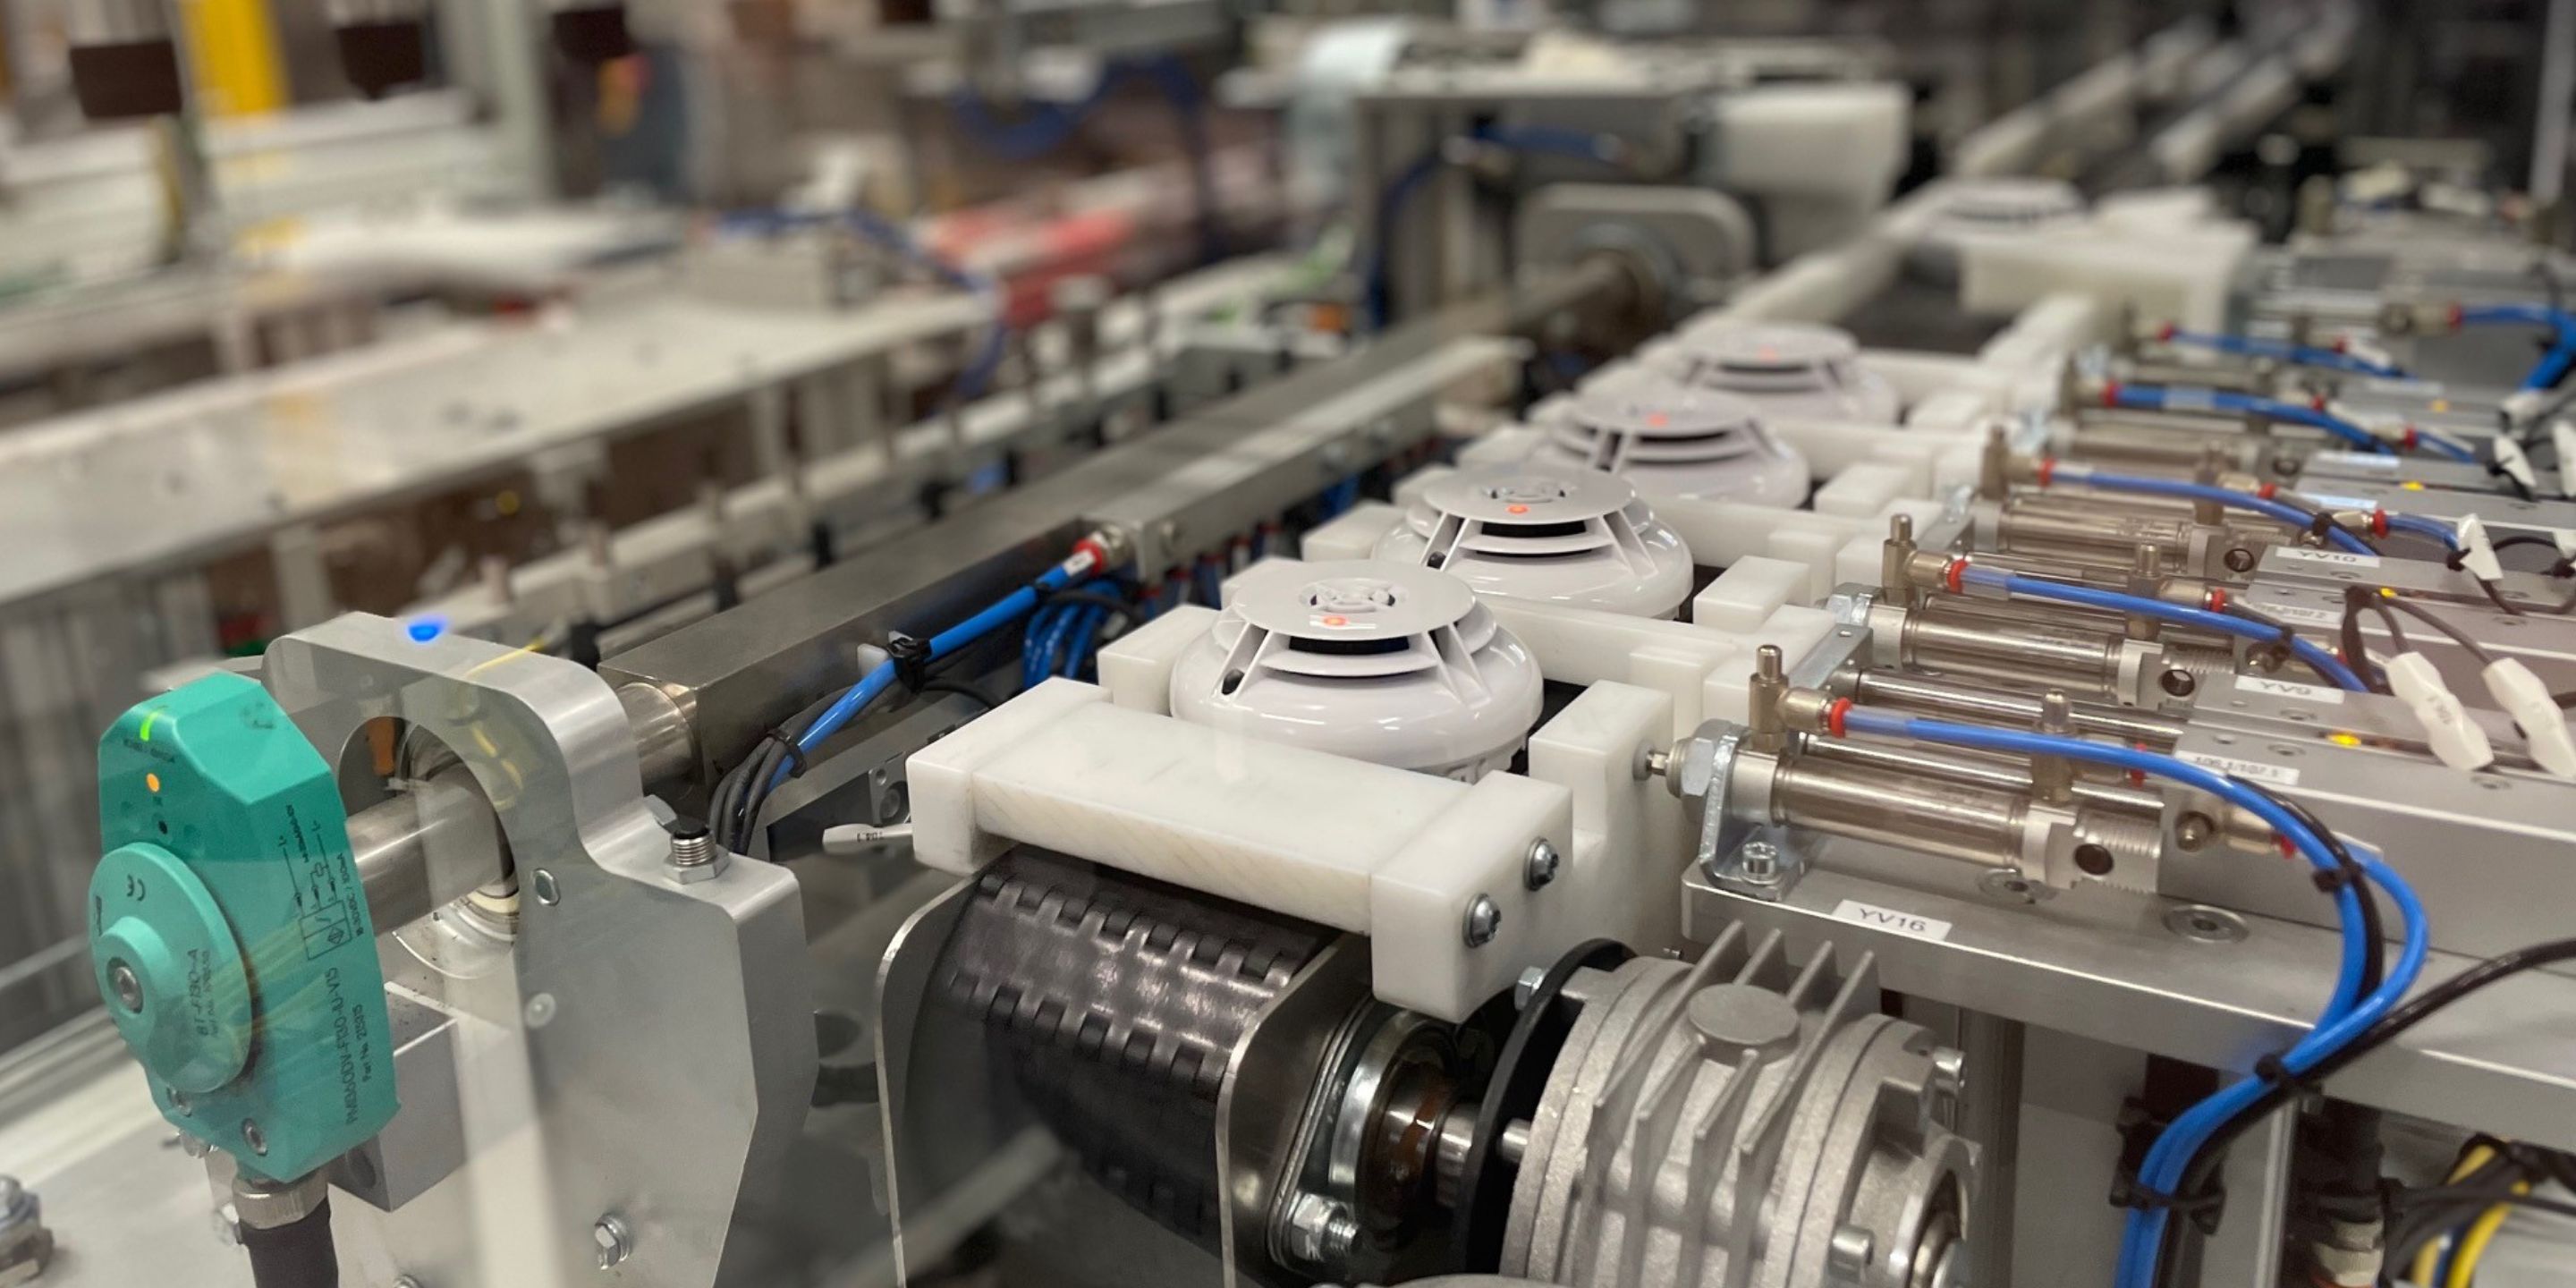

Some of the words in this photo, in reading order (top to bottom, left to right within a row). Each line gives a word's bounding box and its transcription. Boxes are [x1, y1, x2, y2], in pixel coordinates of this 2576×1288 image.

[2298, 550, 2357, 563] YV10
[2259, 681, 2311, 695] YV9
[1860, 908, 1927, 932] YV16
